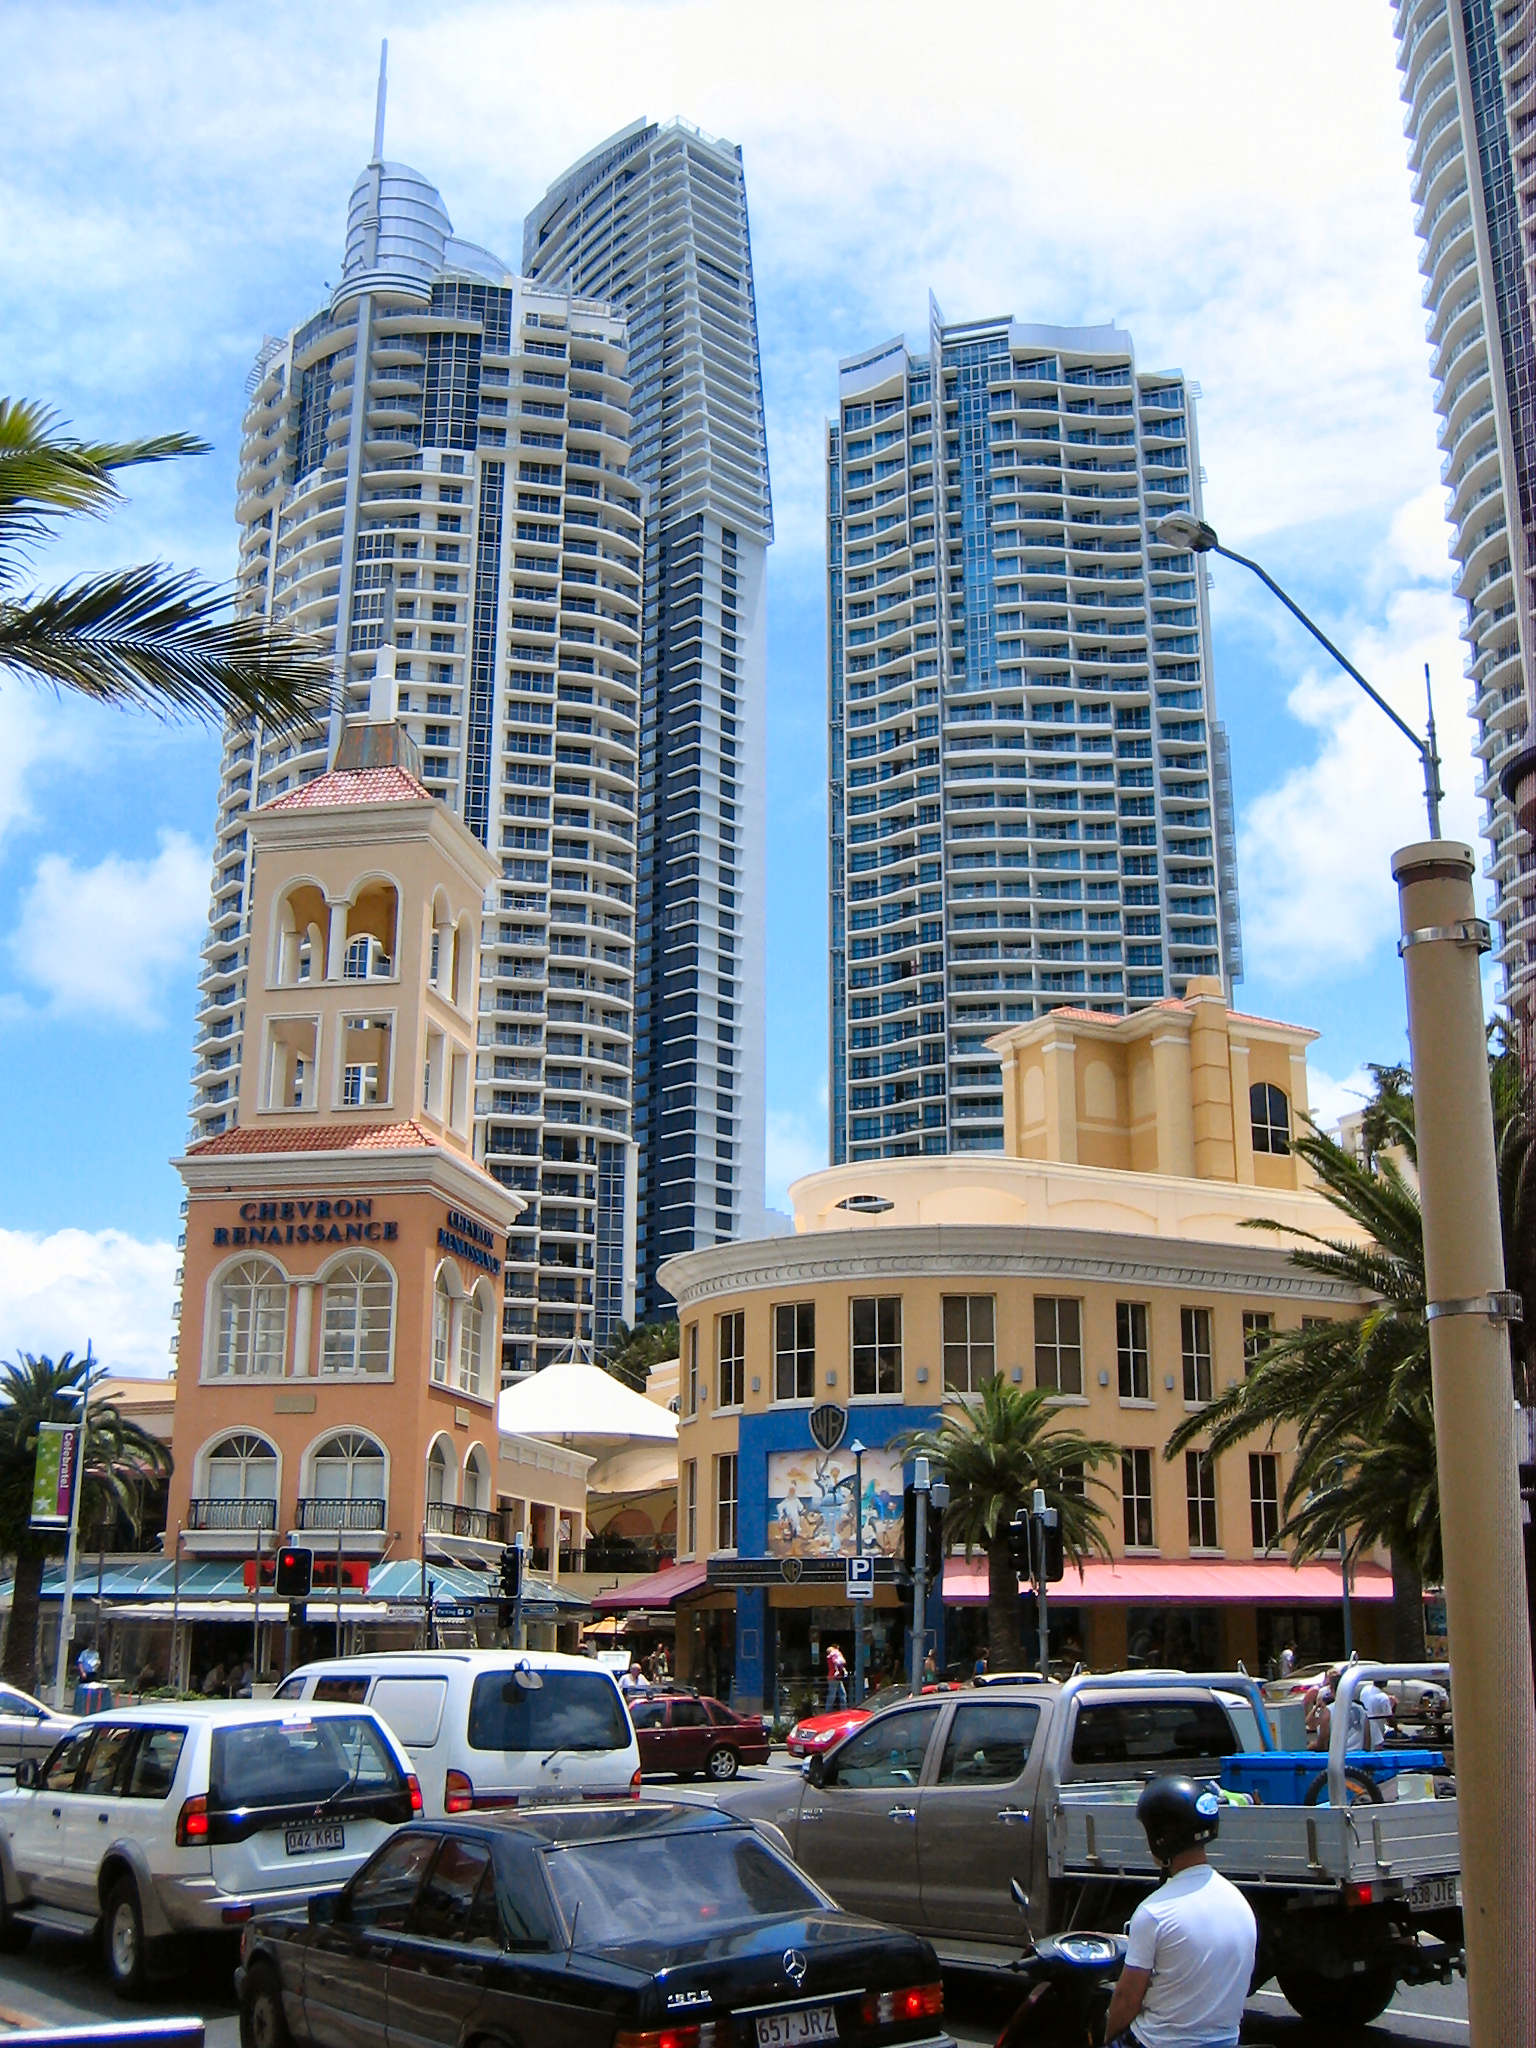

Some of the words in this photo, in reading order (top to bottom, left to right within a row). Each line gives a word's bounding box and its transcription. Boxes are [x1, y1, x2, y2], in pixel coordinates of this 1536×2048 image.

[239, 1199, 373, 1222] CHEVRON
[212, 1221, 399, 1246] RENAISSANCE
[448, 1209, 494, 1250] CHEVRON
[812, 1406, 844, 1449] WB
[60, 1432, 73, 1489] Celebrate!
[852, 1559, 870, 1580] P
[314, 1827, 342, 1847] KRE
